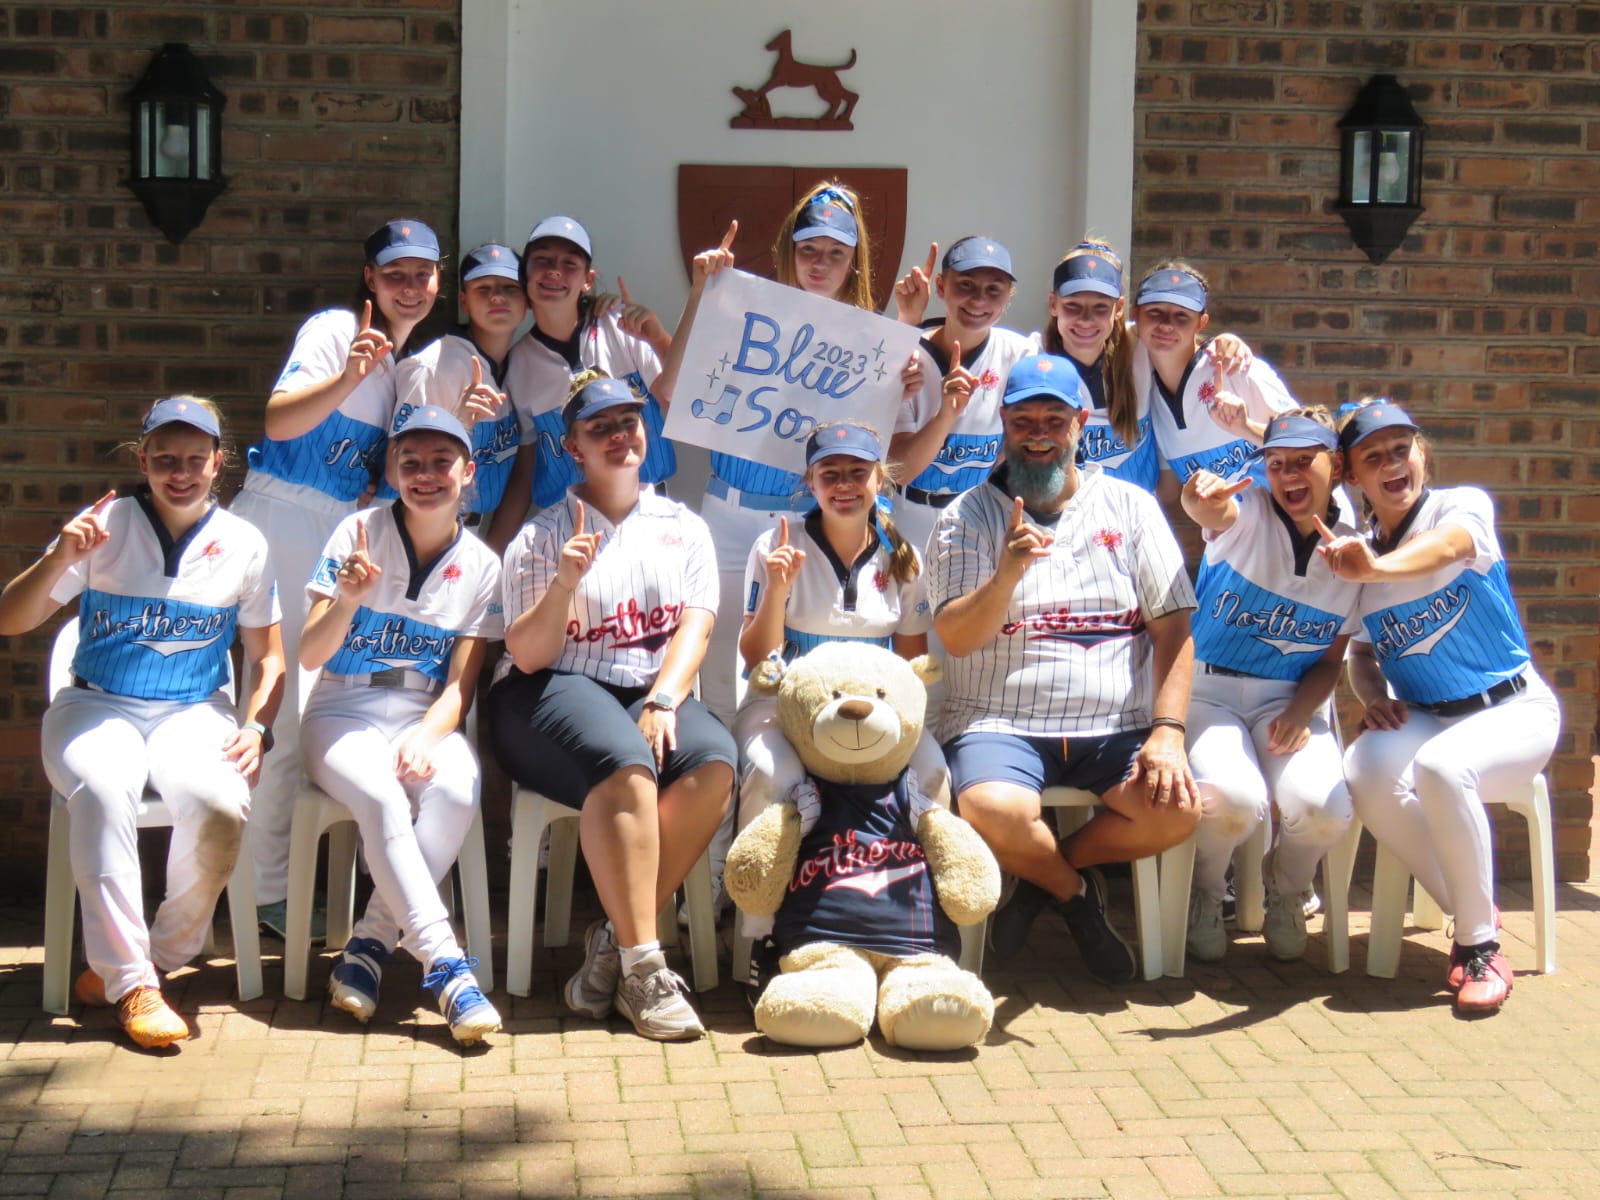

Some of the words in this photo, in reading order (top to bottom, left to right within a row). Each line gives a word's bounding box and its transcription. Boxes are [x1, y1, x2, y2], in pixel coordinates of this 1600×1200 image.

[732, 311, 867, 399] Blue
[812, 341, 868, 375] 2023
[1211, 589, 1337, 641] Northern
